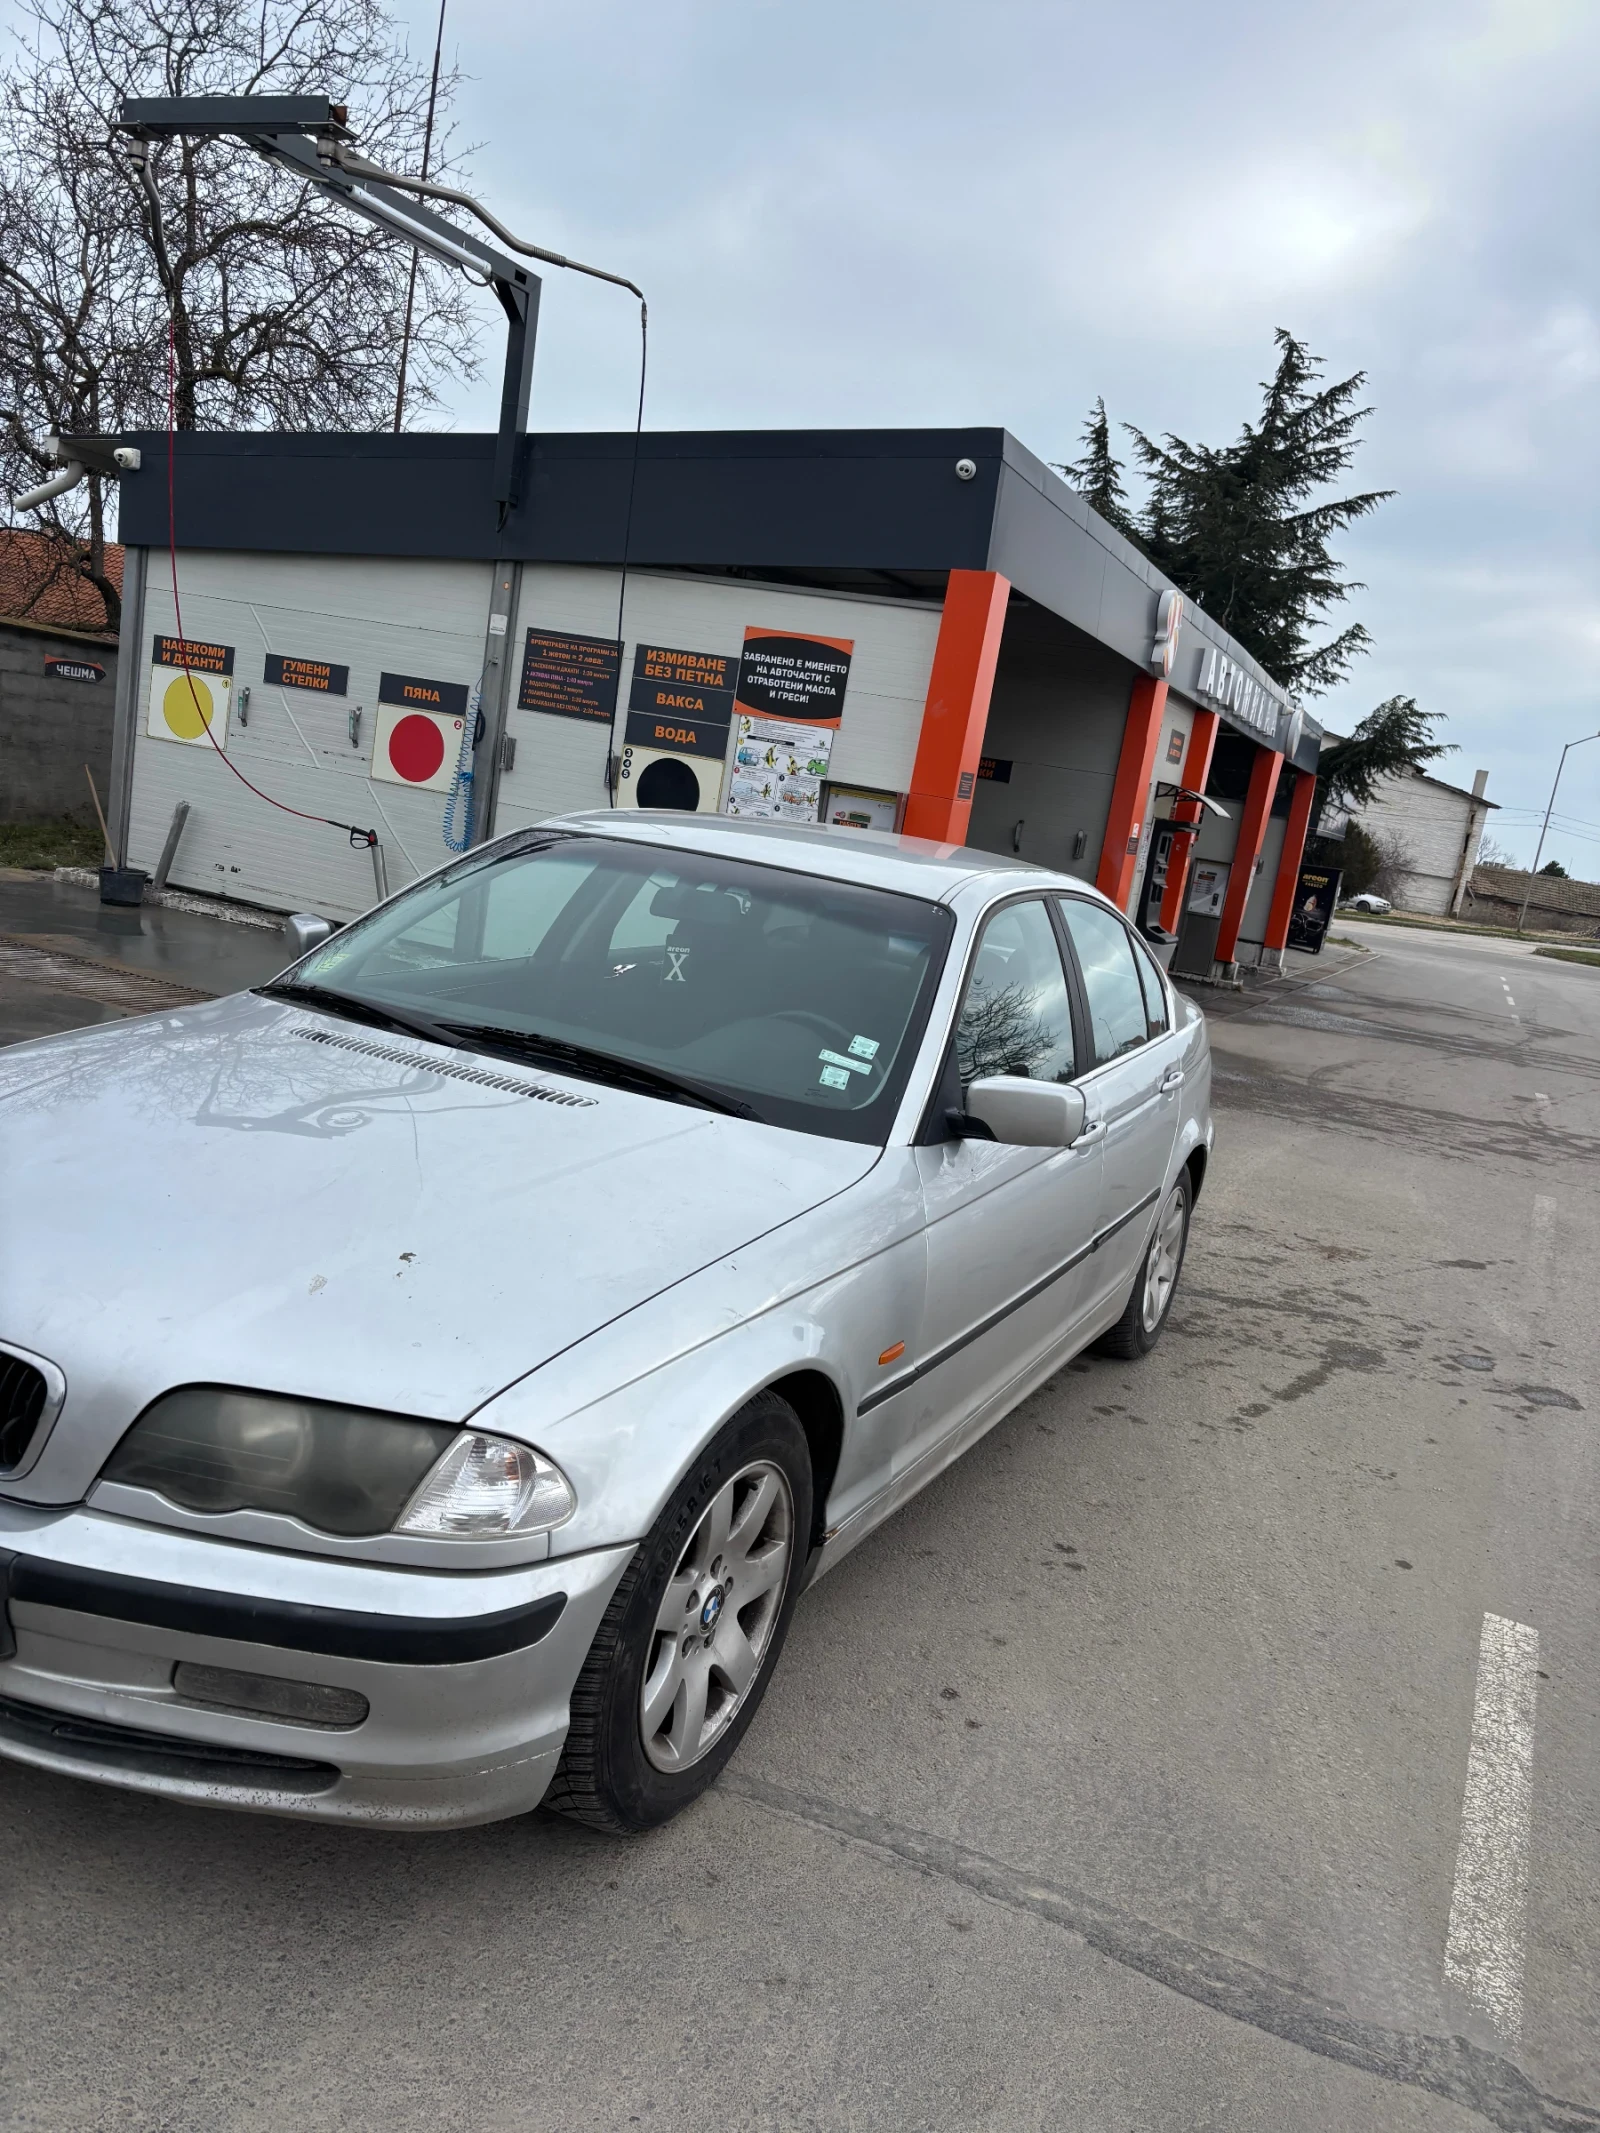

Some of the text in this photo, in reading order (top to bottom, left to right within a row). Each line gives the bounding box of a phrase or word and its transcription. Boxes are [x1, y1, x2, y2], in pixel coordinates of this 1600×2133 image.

[162, 639, 226, 659] НАСЕКОМИ
[162, 651, 224, 671] И ДЖАНТИ
[283, 660, 330, 676] ГУМЕНИ
[646, 650, 727, 672] ИЗМИВАНЕ
[743, 651, 847, 674] ЗАБРАНЕНО Е МИЕНЕТО
[56, 664, 96, 680] ЧЕШМА
[282, 672, 329, 690] СТЕЛКИ
[644, 663, 724, 686] БЕЗ ПЕТНА
[756, 665, 831, 683] НА АВТОЧАСТИ С
[403, 685, 441, 703] ПЯНА
[747, 675, 837, 696] ОТРАБОТЕНИ МАСЛА
[656, 692, 704, 711] ВАКСА
[769, 690, 809, 703] И ГРЕСИ!
[654, 725, 697, 744] ВОДА
[1302, 873, 1329, 883] areon
[664, 953, 689, 981] X
